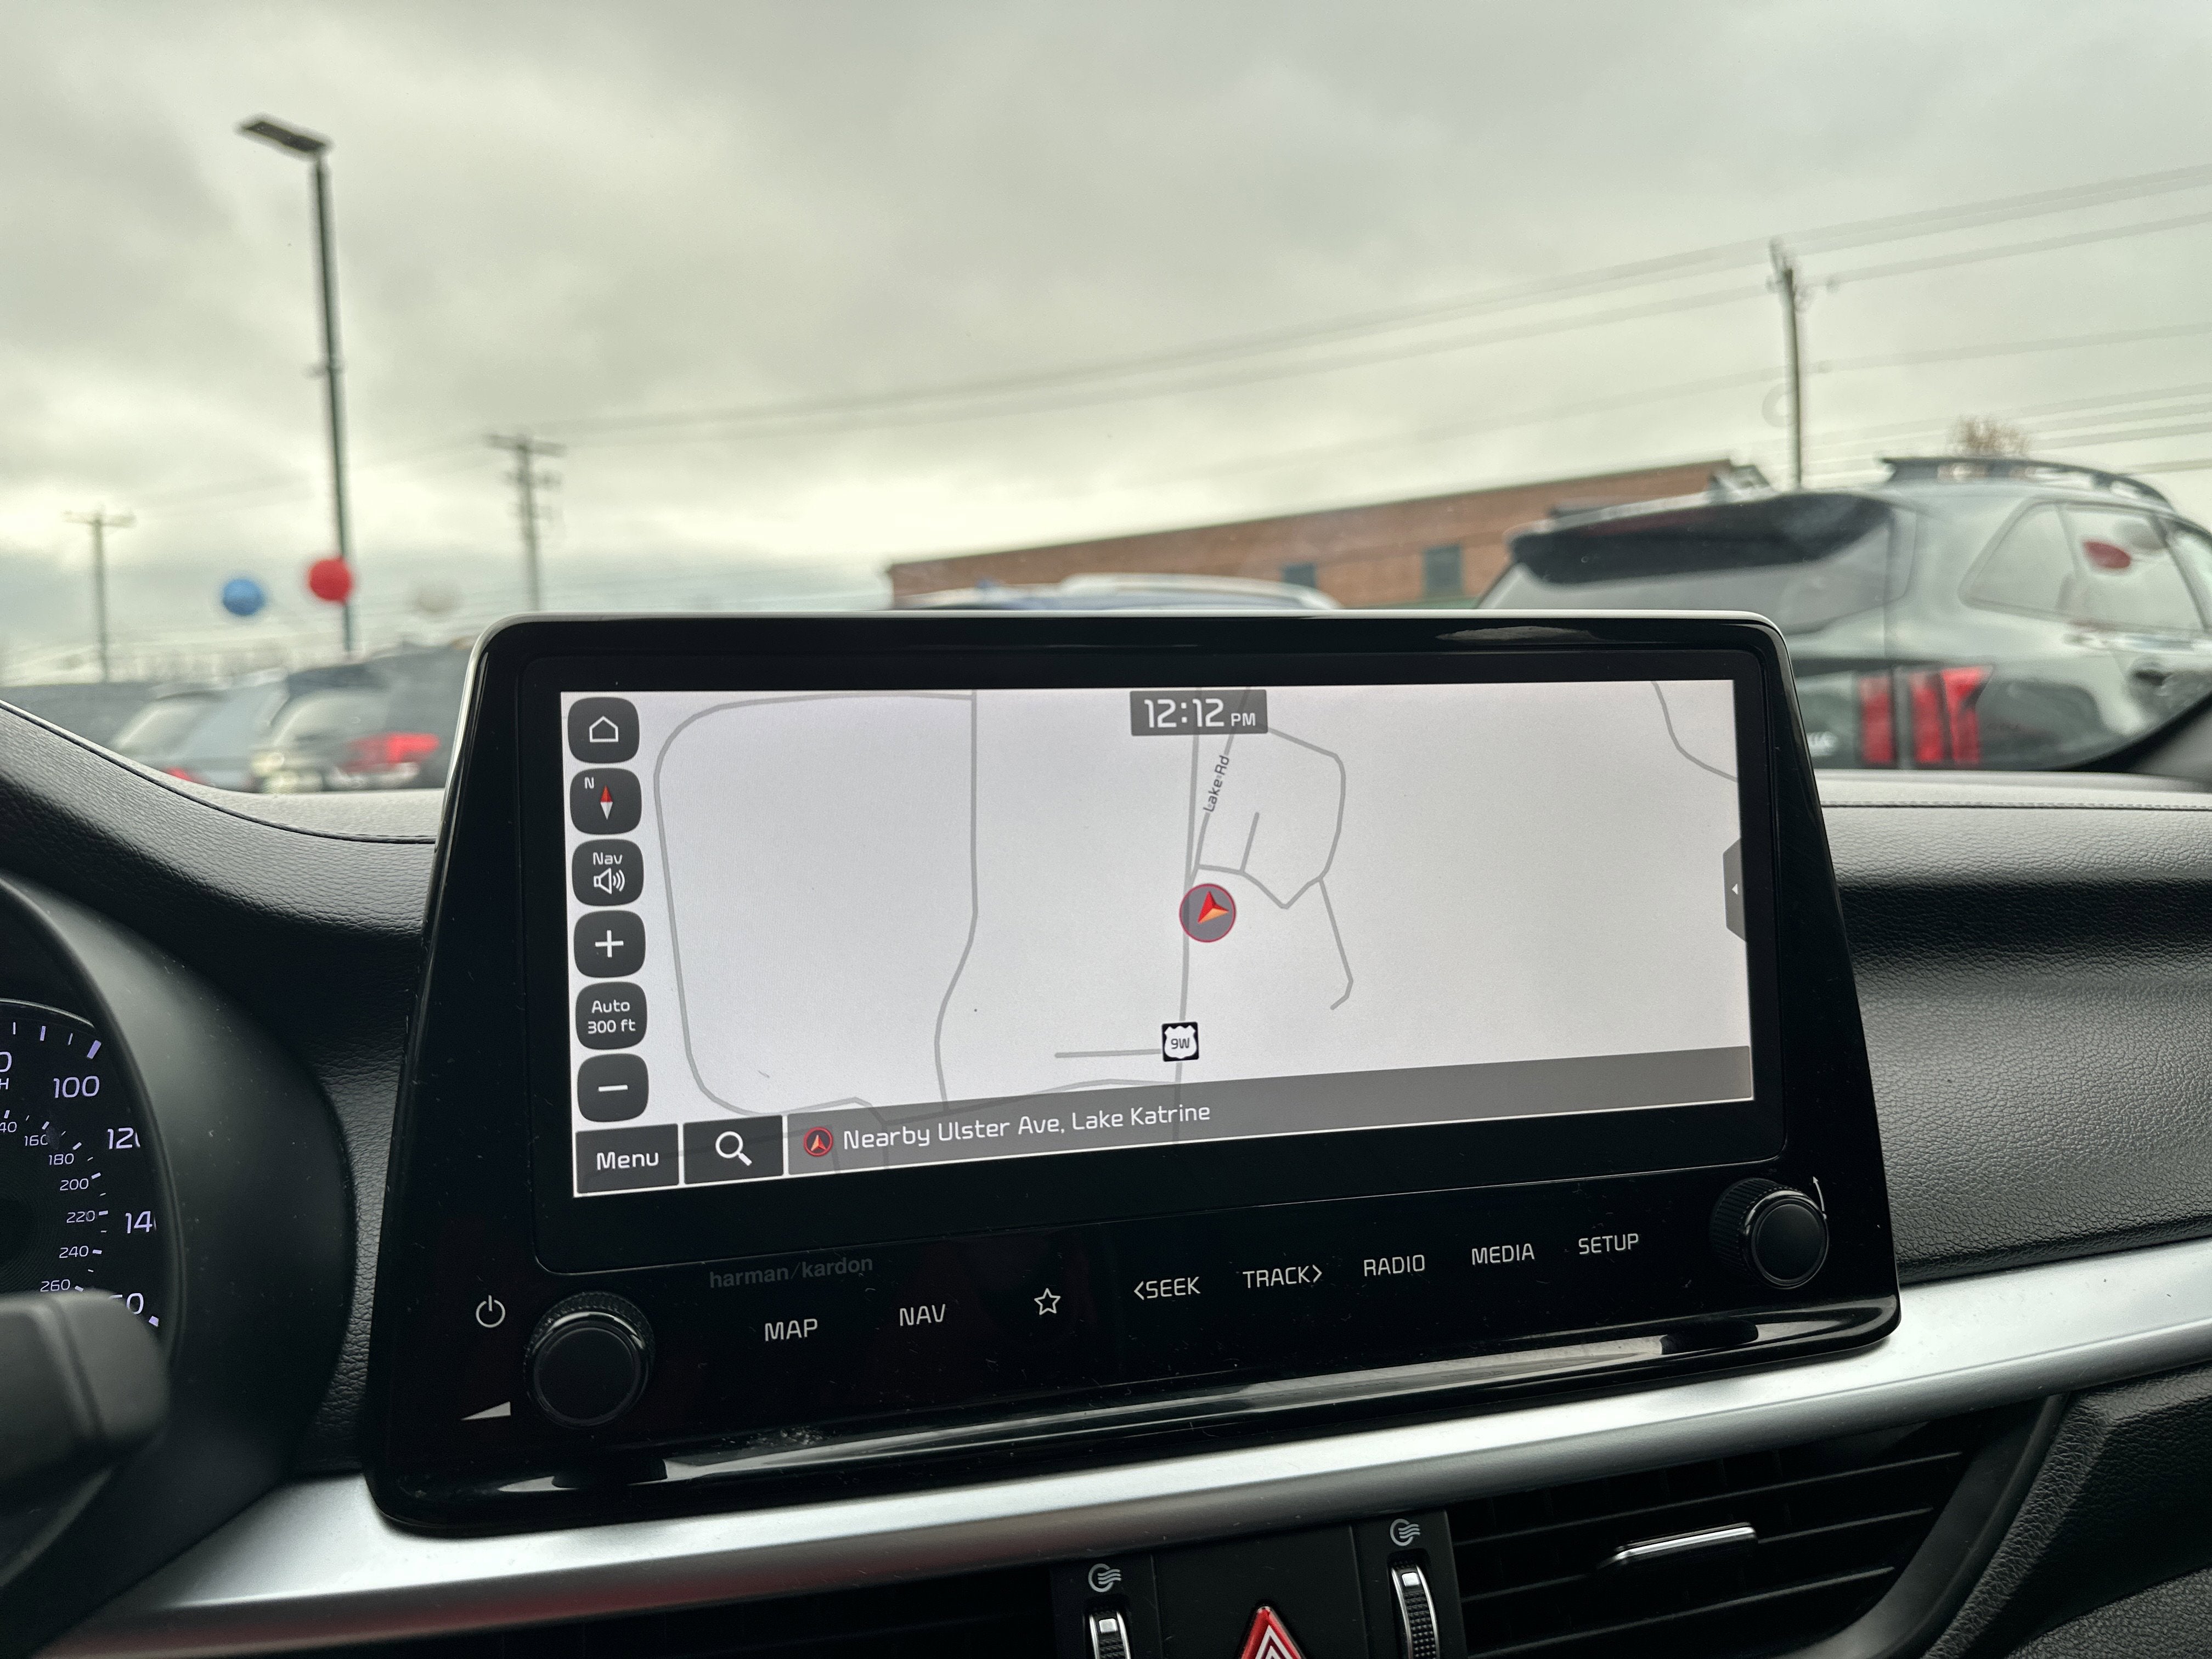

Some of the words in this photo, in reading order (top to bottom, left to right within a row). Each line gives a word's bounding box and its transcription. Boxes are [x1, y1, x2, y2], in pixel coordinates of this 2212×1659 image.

[1144, 699, 1224, 727] 12:12
[1231, 713, 1255, 726] PM
[585, 777, 594, 788] N
[1204, 780, 1222, 811] Lake
[1215, 755, 1229, 775] Rd
[593, 853, 622, 865] Nav
[592, 1000, 630, 1013] Auto
[588, 1020, 616, 1034] 300
[621, 1019, 635, 1031] ft
[1171, 1039, 1189, 1049] 9W
[54, 1076, 99, 1098] 100
[0, 1122, 16, 1132] 40
[844, 1126, 929, 1149] Nearby
[939, 1120, 1010, 1141] Ulster
[1018, 1116, 1064, 1135] Ave,
[1073, 1110, 1123, 1130] Lake
[1131, 1104, 1210, 1125] Katrine
[49, 1154, 74, 1165] 180
[597, 1152, 658, 1170] Menu
[60, 1178, 89, 1190] 200
[67, 1211, 95, 1223] 220
[126, 1211, 156, 1233] 14
[1579, 1233, 1638, 1254] SETUP
[59, 1246, 88, 1258] 240
[1472, 1244, 1534, 1265] MEDIA
[1364, 1255, 1425, 1276] RADIO
[41, 1279, 70, 1291] 260
[900, 1304, 945, 1326] NAV
[765, 1319, 817, 1341] MAP
